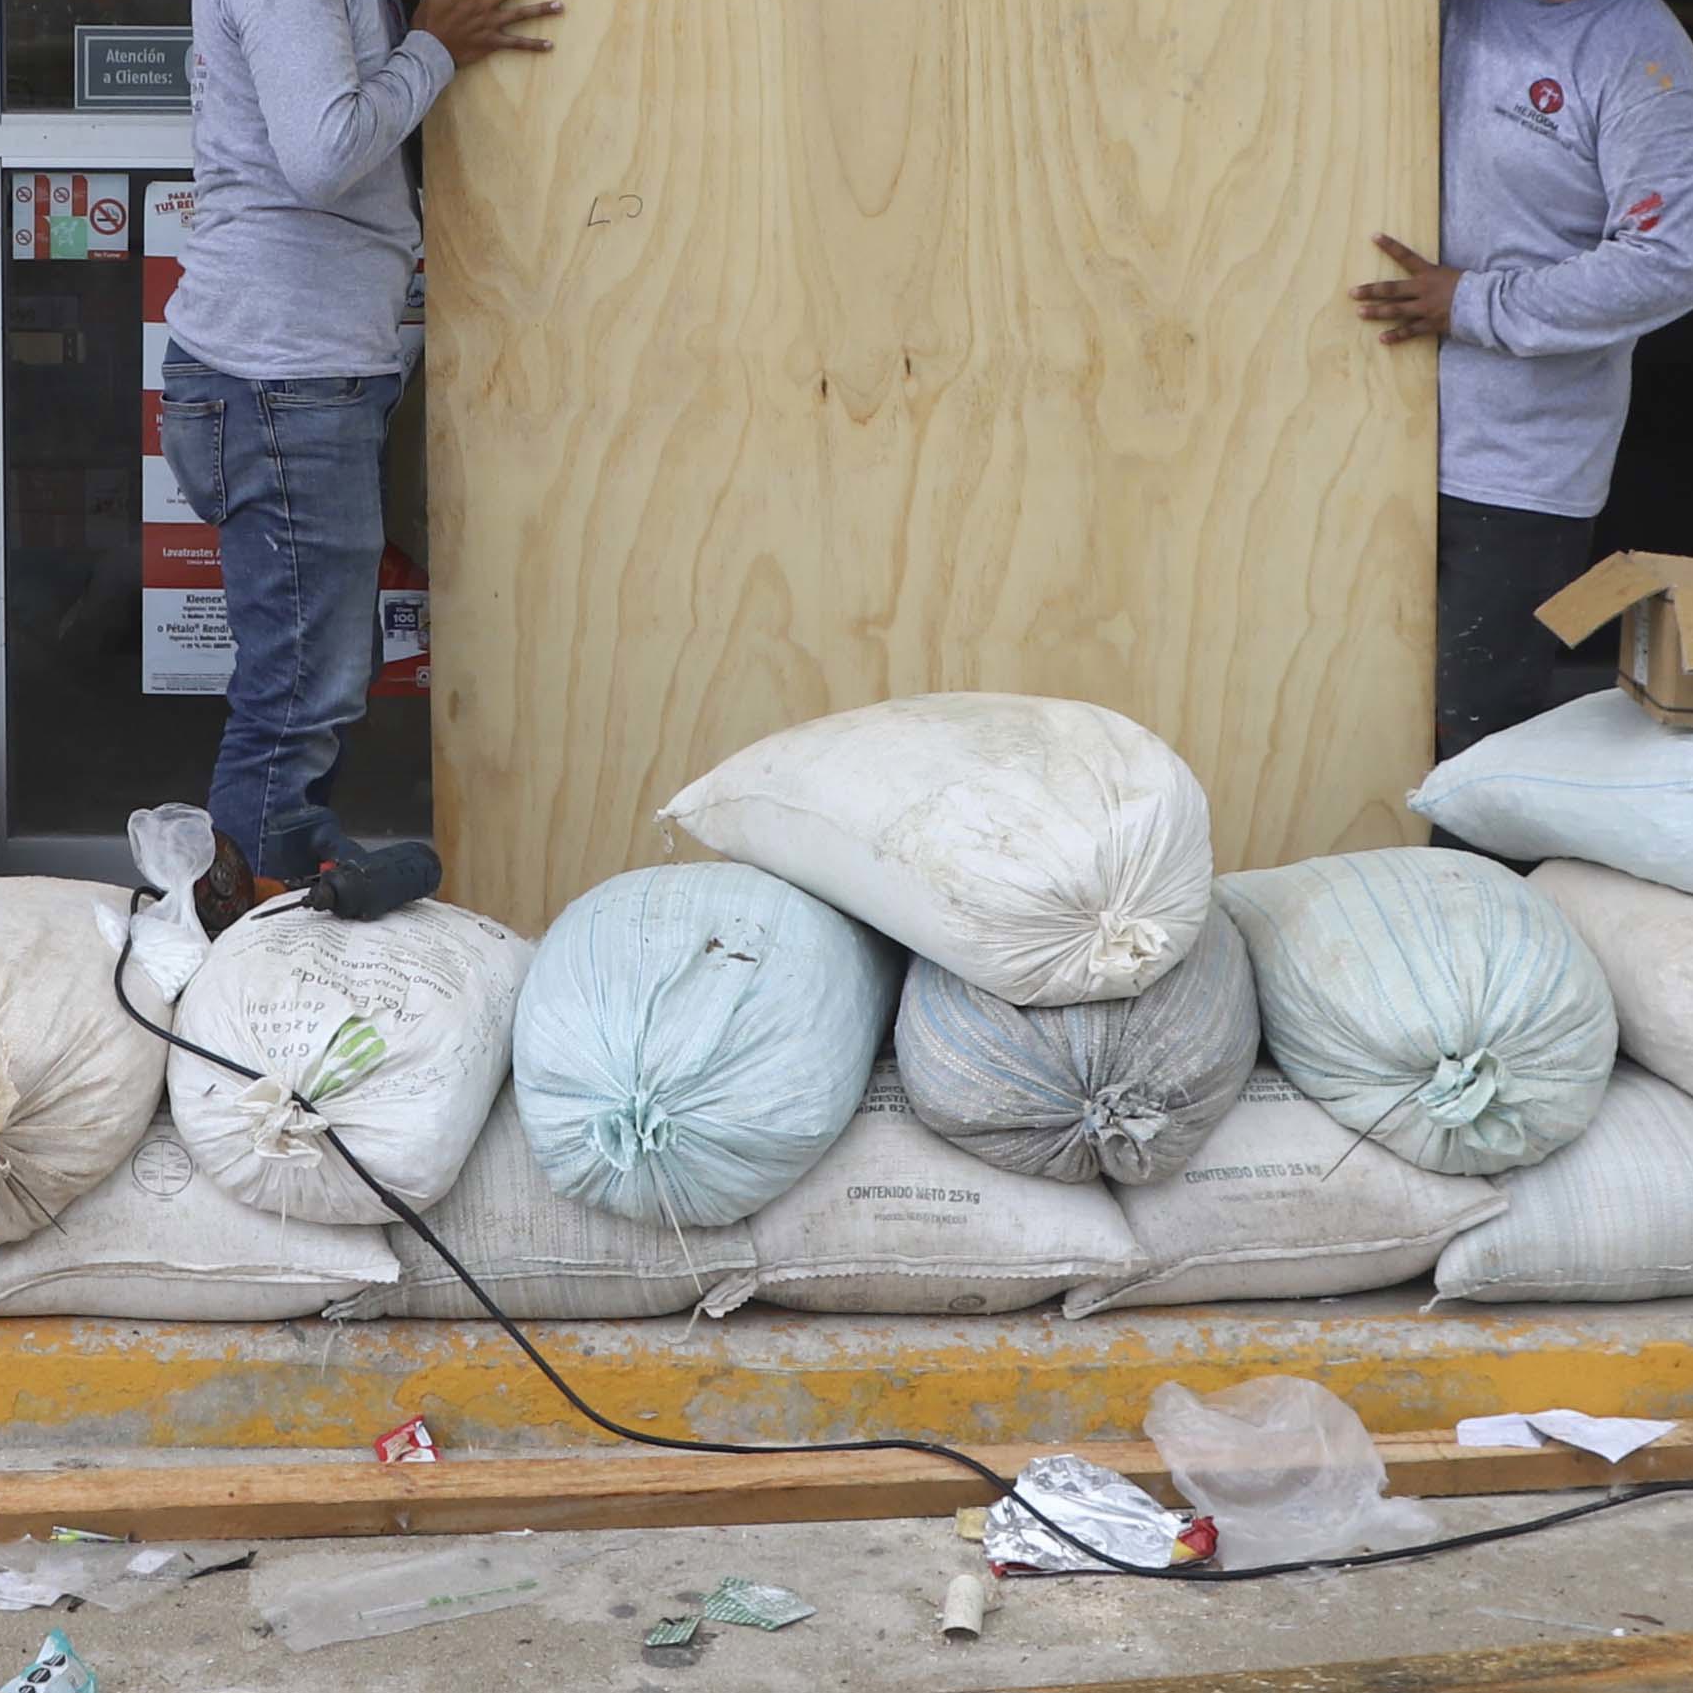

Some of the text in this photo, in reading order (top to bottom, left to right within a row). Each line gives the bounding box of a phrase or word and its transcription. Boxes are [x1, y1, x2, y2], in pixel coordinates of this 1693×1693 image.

[106, 49, 166, 65] Atención
[103, 69, 173, 85] a Clientes:
[168, 192, 193, 200] PARA
[155, 202, 175, 212] TUS
[163, 547, 214, 558] Lavatrastes
[393, 613, 416, 623] 100
[157, 625, 164, 633] o
[1184, 1166, 1253, 1184] CONTENIDO
[1255, 1165, 1287, 1181] NETO
[1288, 1163, 1305, 1177] 25
[846, 1186, 981, 1204] CONTENIDO NETO 25 kg
